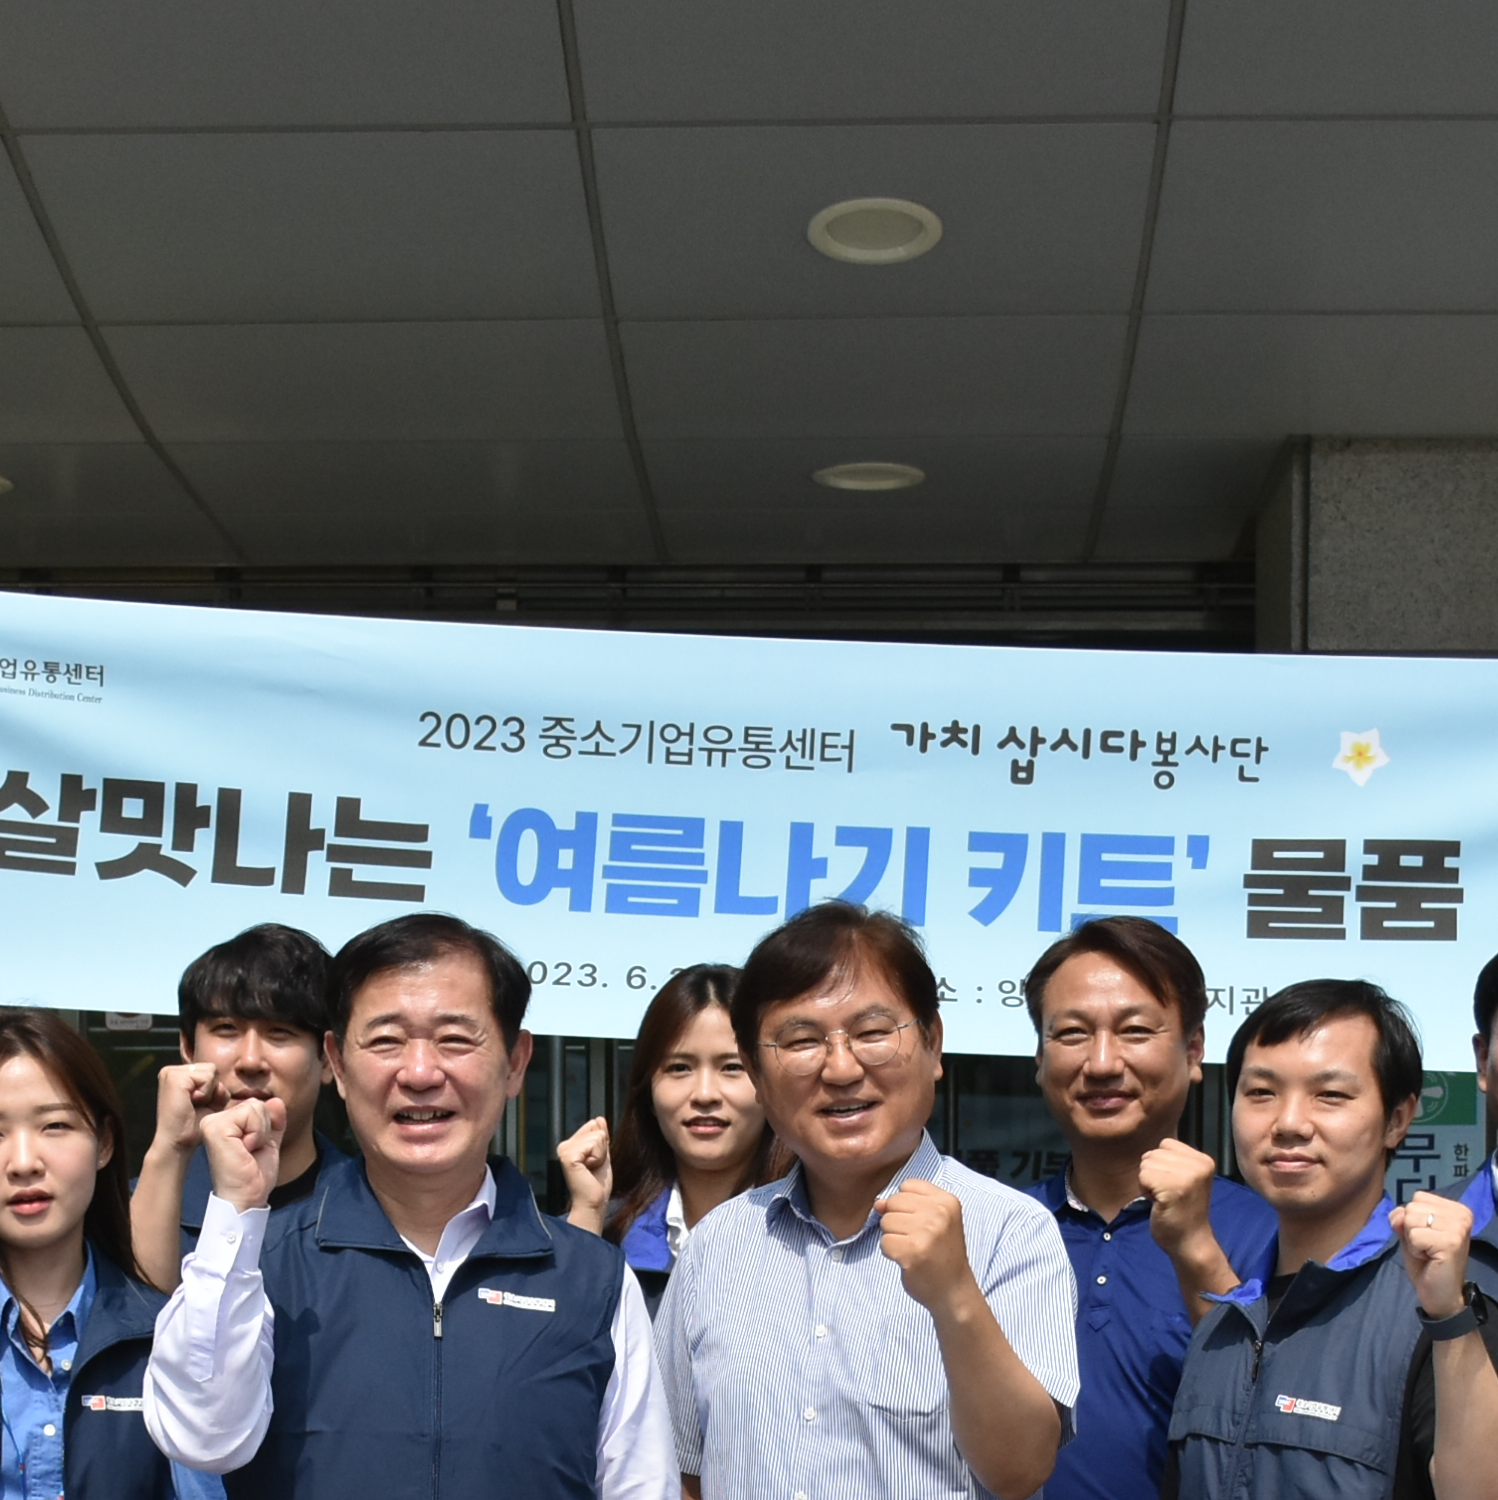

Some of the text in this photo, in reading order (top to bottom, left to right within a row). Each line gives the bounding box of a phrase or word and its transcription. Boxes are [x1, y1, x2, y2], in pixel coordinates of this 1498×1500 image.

[28, 688, 75, 702] Distribution
[77, 693, 102, 704] Center
[418, 711, 526, 755] 2023
[538, 716, 856, 773] 중소기업유통센터
[890, 720, 981, 756] 가치
[1243, 838, 1464, 941] 물품
[526, 960, 657, 990] 023. 6.
[1206, 986, 1269, 1016] 지관
